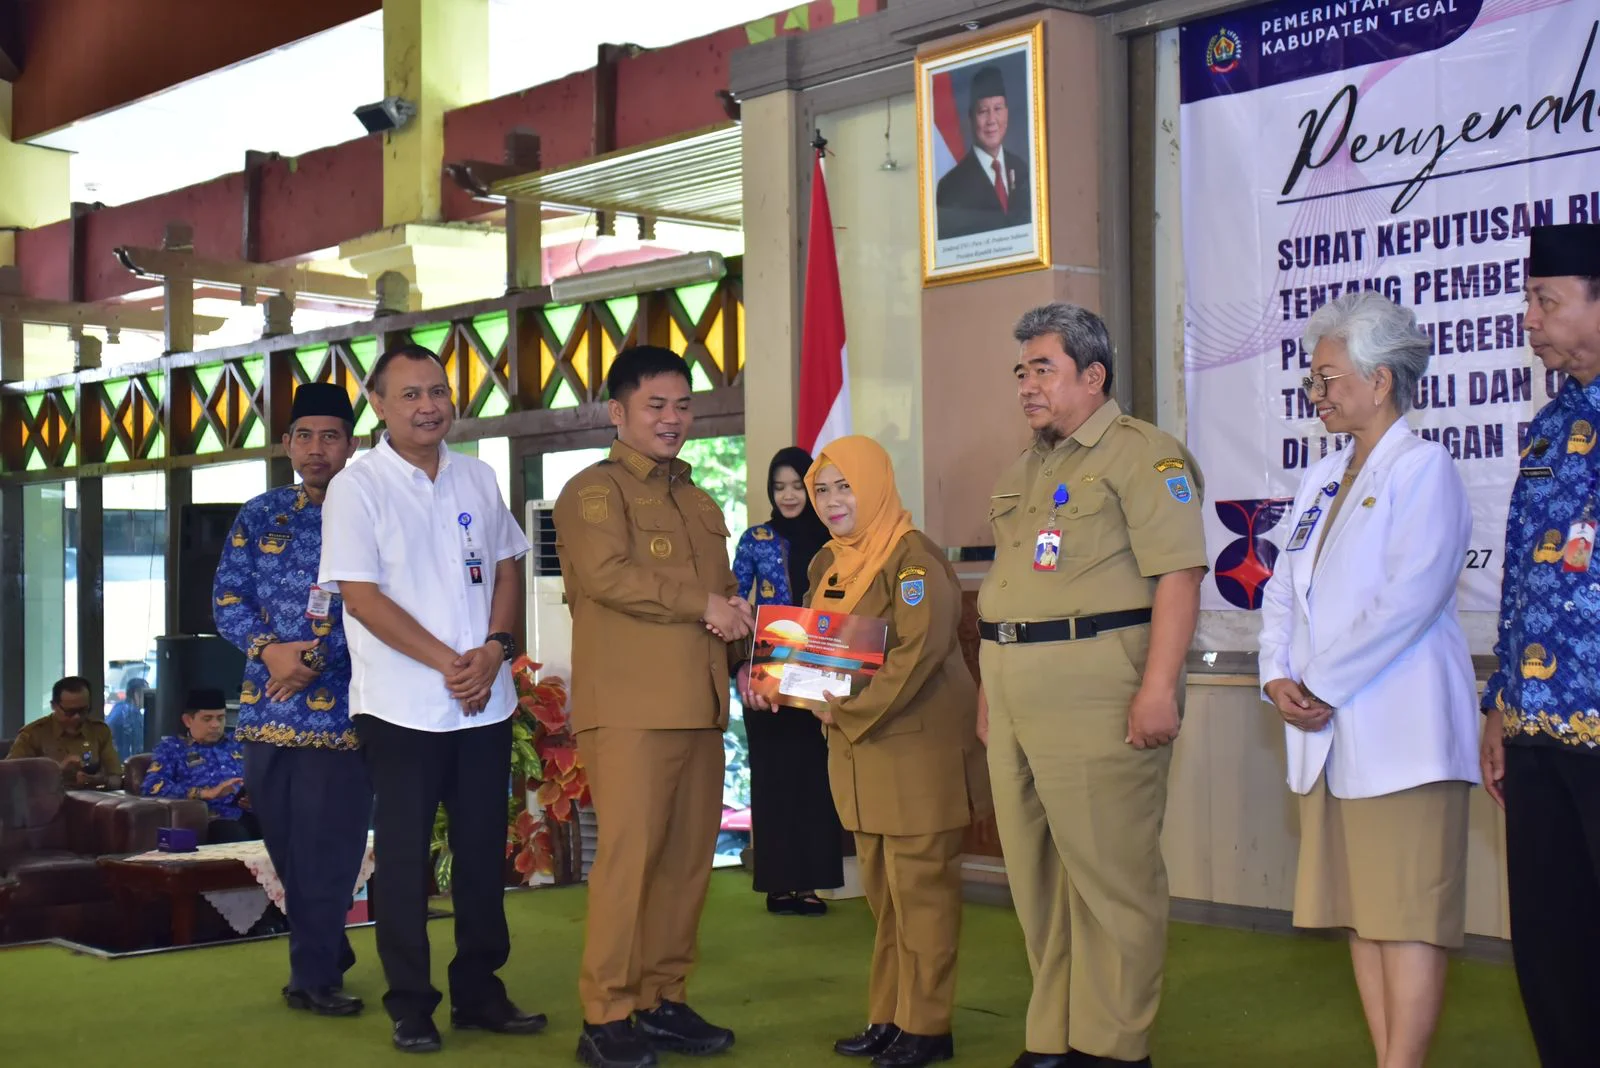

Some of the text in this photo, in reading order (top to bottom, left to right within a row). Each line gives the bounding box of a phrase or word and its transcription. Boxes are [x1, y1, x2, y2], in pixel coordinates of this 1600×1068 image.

[1262, 0, 1458, 56] KABUPATEN TEGAL
[1281, 20, 1600, 214] Penyerah
[1278, 228, 1366, 270] SURAT
[1377, 199, 1553, 258] KEPUTUSAN
[1412, 374, 1456, 410] ULI
[1469, 367, 1532, 406] DAN
[1283, 437, 1308, 469] DI
[1466, 549, 1492, 569] 27
